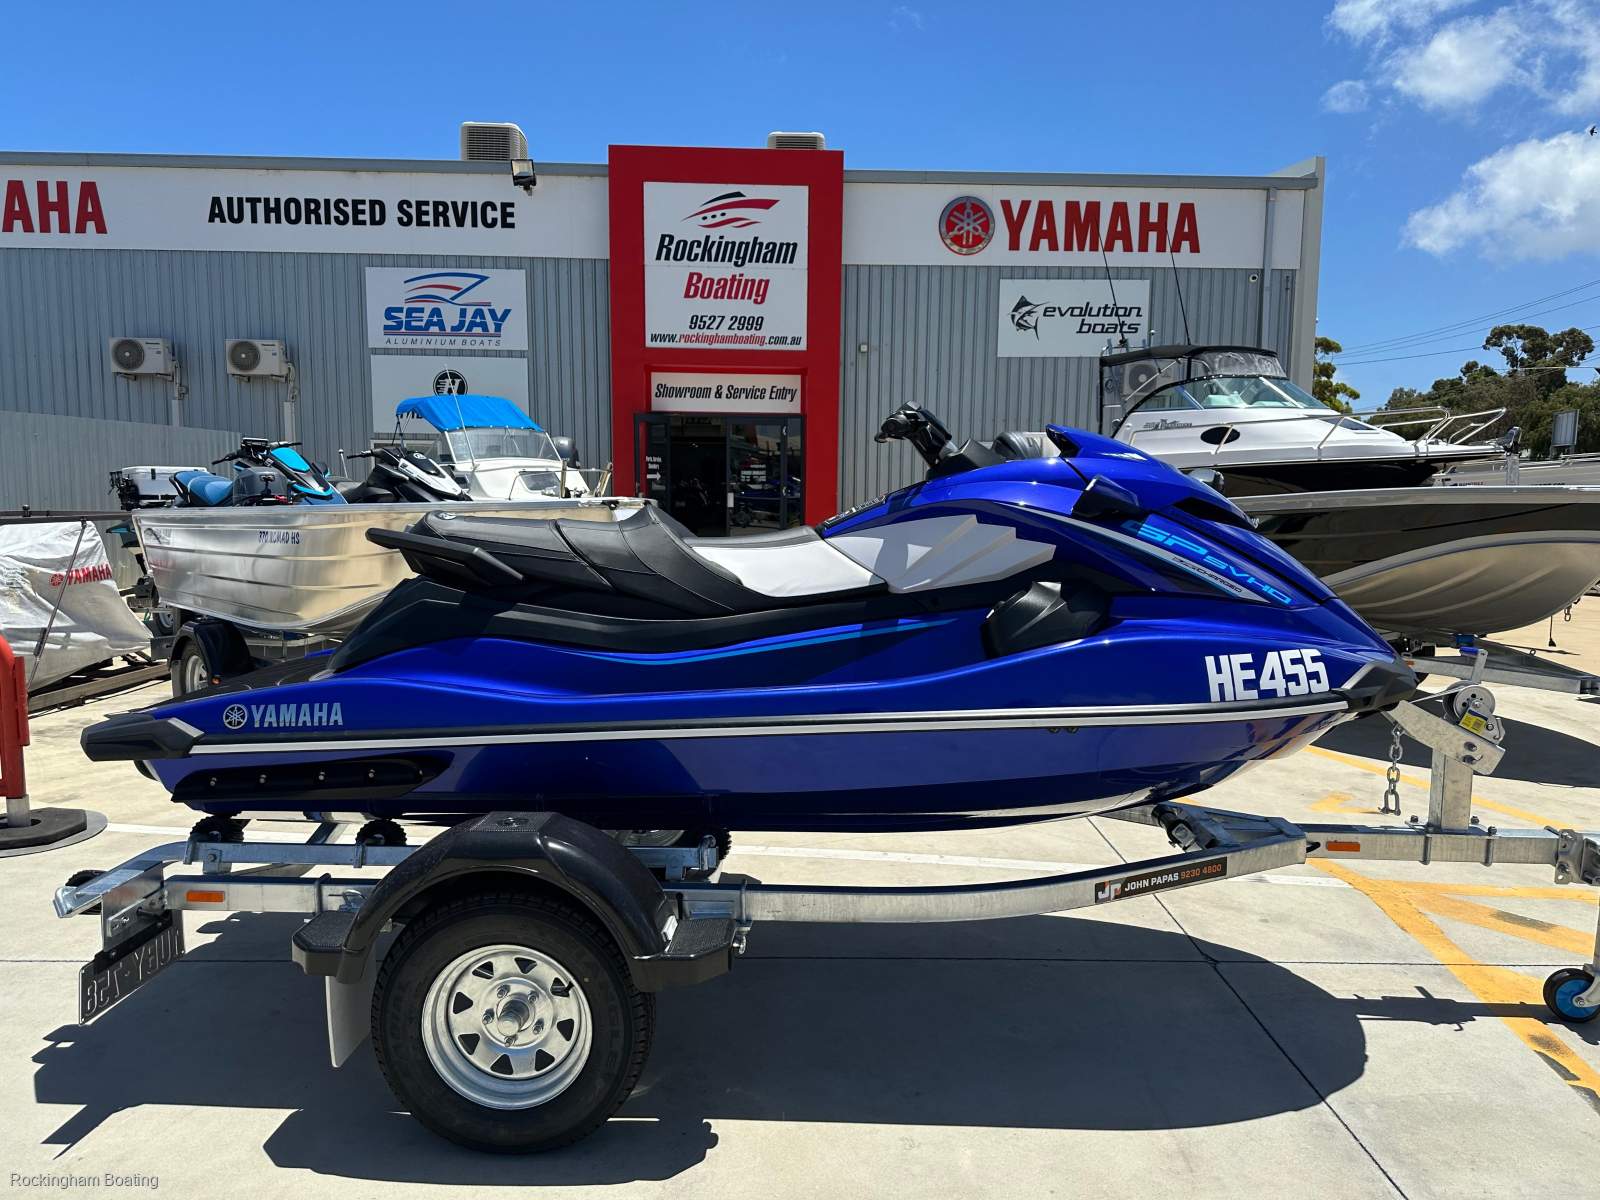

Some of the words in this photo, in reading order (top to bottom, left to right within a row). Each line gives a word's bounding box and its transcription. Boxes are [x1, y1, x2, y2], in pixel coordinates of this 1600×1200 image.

[208, 196, 386, 226] AUTHORISED
[397, 200, 516, 229] SERVICE
[1000, 199, 1201, 253] YAMAHA
[655, 233, 798, 268] Rockingham
[684, 271, 770, 305] Boating
[383, 306, 446, 333] SEA
[449, 308, 513, 333] JAY
[1043, 301, 1142, 318] evolution
[689, 314, 726, 331] 9527
[728, 315, 764, 332] 2999
[1076, 318, 1141, 334] boats
[385, 337, 457, 346] ALUMINIUM
[461, 338, 502, 347] BOATS
[650, 332, 802, 347] www.rockinghamboating.com.au
[655, 383, 711, 401] Showroom
[714, 385, 723, 400] &
[726, 385, 766, 401] Service
[769, 385, 797, 403] Entry
[291, 531, 300, 545] HS
[66, 563, 112, 586] YAMAHA
[1203, 554, 1292, 605] SVHO
[251, 702, 343, 728] YAMAHA
[1125, 879, 1149, 892] JOHN
[1151, 872, 1179, 886] PAPAS
[1181, 867, 1201, 880] 9230
